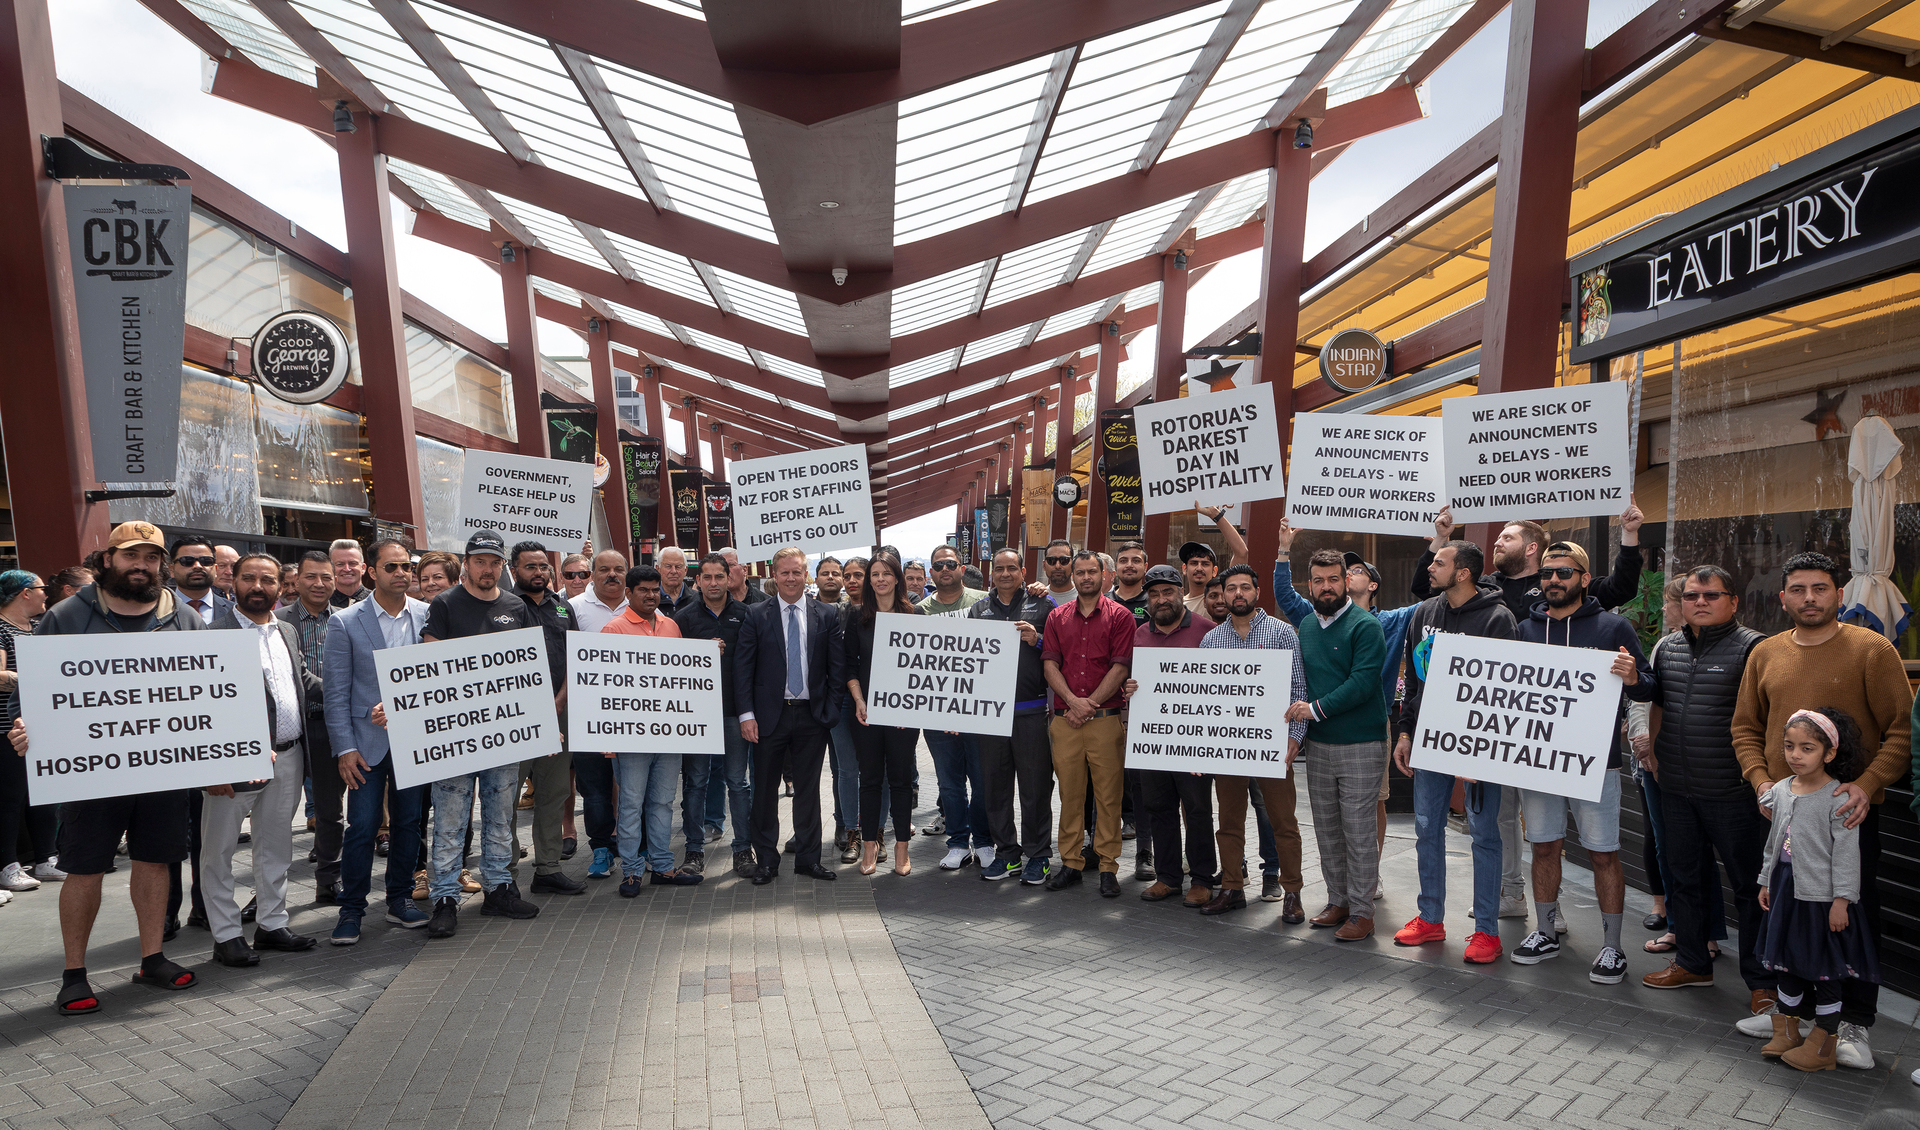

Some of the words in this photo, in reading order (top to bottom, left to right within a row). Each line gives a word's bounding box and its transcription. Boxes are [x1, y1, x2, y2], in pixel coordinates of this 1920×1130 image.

[83, 217, 175, 266] CBK
[1646, 167, 1879, 310] EATERY
[121, 296, 142, 366] KITCHEN
[279, 338, 314, 348] GOOD
[1330, 348, 1381, 361] INDIAN
[267, 348, 330, 374] George
[1335, 363, 1376, 377] STAR
[123, 370, 143, 382] &
[124, 387, 143, 419] BAR
[1472, 409, 1495, 423] WE
[1497, 406, 1528, 420] ARE
[1531, 402, 1568, 417] SICK
[1571, 400, 1592, 413] OF
[1151, 404, 1258, 438] ROTORUA'S
[1162, 425, 1249, 456] DARKEST
[1321, 427, 1342, 439] WE
[1343, 428, 1371, 440] ARE
[1373, 429, 1406, 442] SICK
[1408, 431, 1427, 442] OF
[1467, 421, 1598, 445] ANNOUNCMENTS
[125, 424, 145, 474] CRAFT
[635, 452, 650, 460] Hair
[651, 451, 659, 460] &
[1314, 446, 1429, 462] ANNOUNCMENTS
[1478, 453, 1488, 465] &
[1492, 448, 1550, 464] DELAYS
[1564, 444, 1589, 458] WE
[624, 446, 635, 480] Service
[635, 459, 661, 469] Beauty
[1176, 452, 1214, 474] DAY
[1219, 448, 1240, 467] IN
[485, 466, 572, 488] GOVERNMENT,
[737, 470, 776, 487] OPEN
[778, 466, 807, 481] THE
[809, 459, 859, 477] DOORS
[1108, 475, 1141, 487] Wild
[1148, 464, 1274, 498] HOSPITALITY
[1320, 466, 1330, 477] &
[1333, 467, 1385, 480] DELAYS
[1398, 470, 1419, 482] WE
[1459, 474, 1496, 488] NEED
[1499, 471, 1532, 485] OUR
[1534, 465, 1612, 482] WORKERS
[478, 483, 525, 498] PLEASE
[526, 489, 557, 502] HELP
[559, 493, 576, 504] US
[627, 482, 638, 505] Skills
[738, 493, 758, 507] NZ
[761, 489, 789, 504] FOR
[792, 479, 862, 500] STAFFING
[1110, 491, 1139, 505] Rice
[1301, 484, 1335, 497] NEED
[1338, 487, 1366, 499] OUR
[1369, 488, 1436, 503] WORKERS
[1451, 495, 1486, 509] NOW
[1489, 488, 1596, 507] IMMIGRATION
[1599, 486, 1622, 500] NZ
[492, 503, 531, 516] STAFF
[533, 507, 559, 520] OUR
[630, 506, 641, 537] Centre
[760, 506, 815, 525] BEFORE
[818, 503, 845, 517] ALL
[1117, 511, 1132, 520] Thai
[1292, 503, 1323, 516] NOW
[1326, 505, 1419, 522] IMMIGRATION
[464, 517, 507, 531] HOSPO
[509, 522, 583, 540] BUSINESSES
[750, 529, 802, 547] LIGHTS
[805, 526, 826, 539] GO
[829, 521, 859, 536] OUT
[981, 512, 990, 558] SOBAR
[1112, 522, 1138, 531] Cuisine
[888, 631, 1001, 655] ROTORUA'S
[60, 654, 225, 677] GOVERNMENT,
[389, 661, 440, 684] OPEN
[442, 655, 479, 675] THE
[481, 646, 538, 669] DOORS
[577, 648, 621, 664] OPEN
[624, 651, 657, 666] THE
[660, 653, 712, 669] DOORS
[897, 652, 990, 675] DARKEST
[1159, 661, 1179, 674] WE
[1181, 662, 1208, 674] ARE
[1210, 663, 1241, 675] SICK
[1244, 664, 1262, 676] OF
[577, 672, 600, 686] NZ
[603, 673, 635, 688] FOR
[639, 675, 714, 691] STAFFING
[907, 673, 949, 692] DAY
[953, 677, 974, 695] IN
[1448, 656, 1597, 694] ROTORUA'S
[51, 688, 143, 710] PLEASE
[147, 685, 203, 704] HELP
[209, 682, 238, 699] US
[393, 693, 420, 712] NZ
[422, 686, 459, 707] FOR
[462, 671, 543, 699] STAFFING
[1153, 682, 1265, 697] ANNOUNCMENTS
[1455, 682, 1578, 718] DARKEST
[600, 697, 662, 712] BEFORE
[665, 699, 694, 713] ALL
[873, 690, 1006, 718] HOSPITALITY
[1159, 703, 1169, 714] &
[1172, 703, 1222, 717] DELAYS
[1235, 705, 1256, 718] WE
[88, 718, 161, 740] STAFF
[167, 714, 213, 733] OUR
[424, 707, 492, 735] BEFORE
[495, 702, 526, 721] ALL
[587, 720, 646, 736] LIGHTS
[649, 722, 672, 736] GO
[676, 723, 708, 737] OUT
[1466, 709, 1521, 736] DAY
[1525, 718, 1554, 743] IN
[1141, 722, 1174, 735] NEED
[1176, 724, 1204, 737] OUR
[1207, 725, 1273, 740] WORKERS
[413, 738, 478, 766] LIGHTS
[481, 732, 505, 750] GO
[509, 723, 542, 744] OUT
[1132, 742, 1163, 755] NOW
[1165, 744, 1257, 761] IMMIGRATION
[1260, 749, 1280, 762] NZ
[1421, 728, 1596, 777] HOSPITALITY
[35, 753, 121, 777] HOSPO
[127, 740, 262, 768] BUSINESSES
